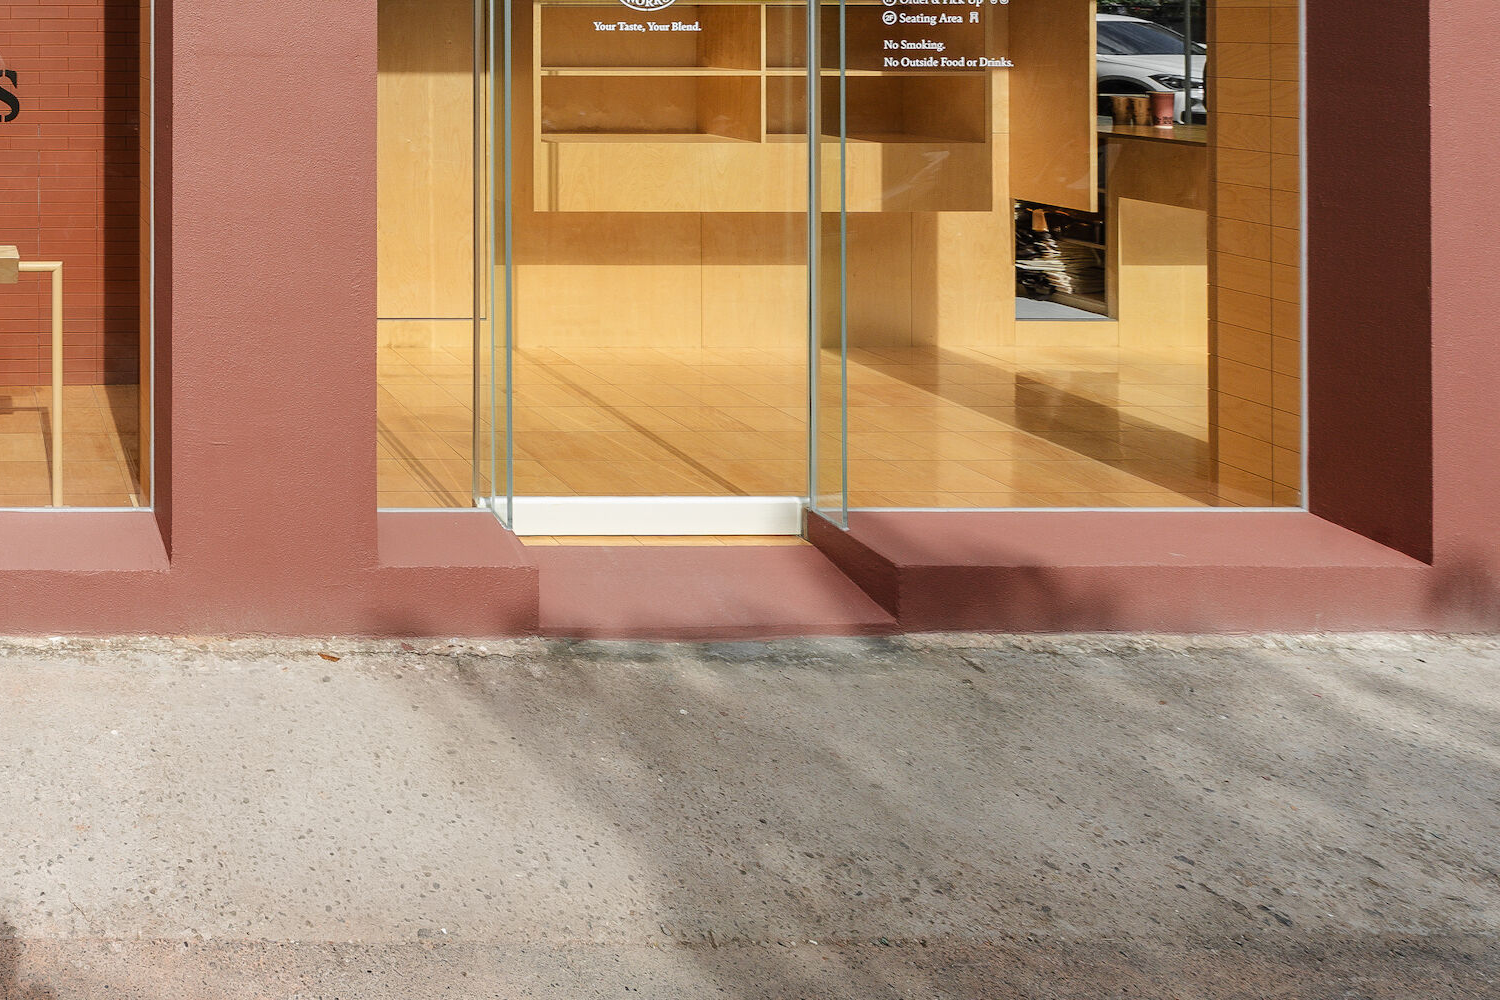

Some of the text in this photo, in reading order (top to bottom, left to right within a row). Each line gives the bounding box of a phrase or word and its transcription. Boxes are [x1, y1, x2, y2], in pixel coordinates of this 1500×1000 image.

[899, 12, 937, 26] Seating
[938, 12, 963, 24] Area
[593, 21, 702, 33] Your Taste, Your Blend.
[883, 39, 946, 52] No Smoking.
[883, 56, 1014, 68] No Outside Food or Drinks.
